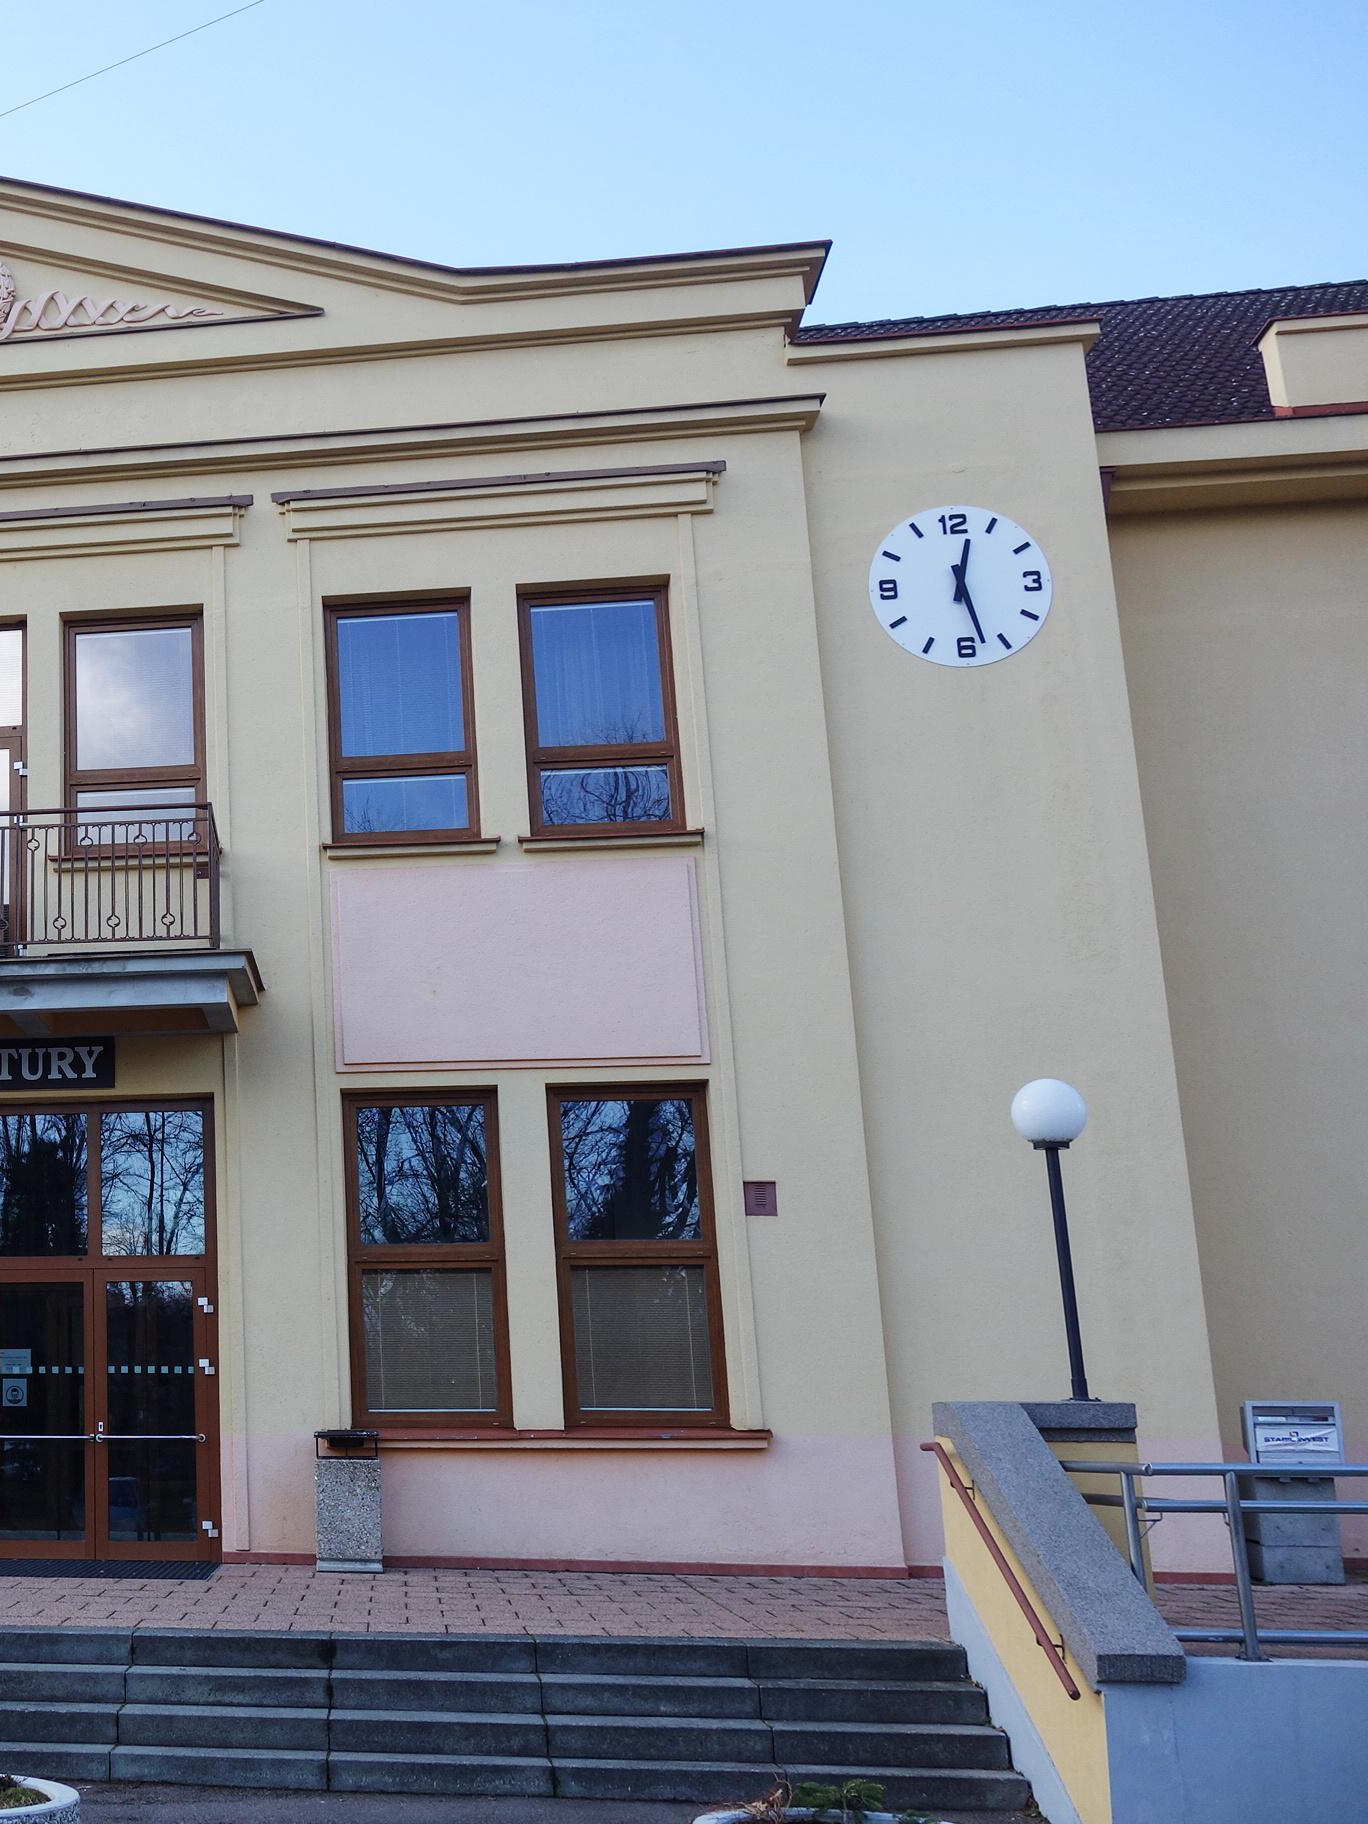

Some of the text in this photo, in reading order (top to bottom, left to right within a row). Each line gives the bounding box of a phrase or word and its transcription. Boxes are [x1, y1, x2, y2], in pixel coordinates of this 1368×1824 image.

[938, 513, 969, 535] 12
[879, 579, 898, 600] 9
[1022, 570, 1043, 592] 3
[956, 636, 977, 658] 6
